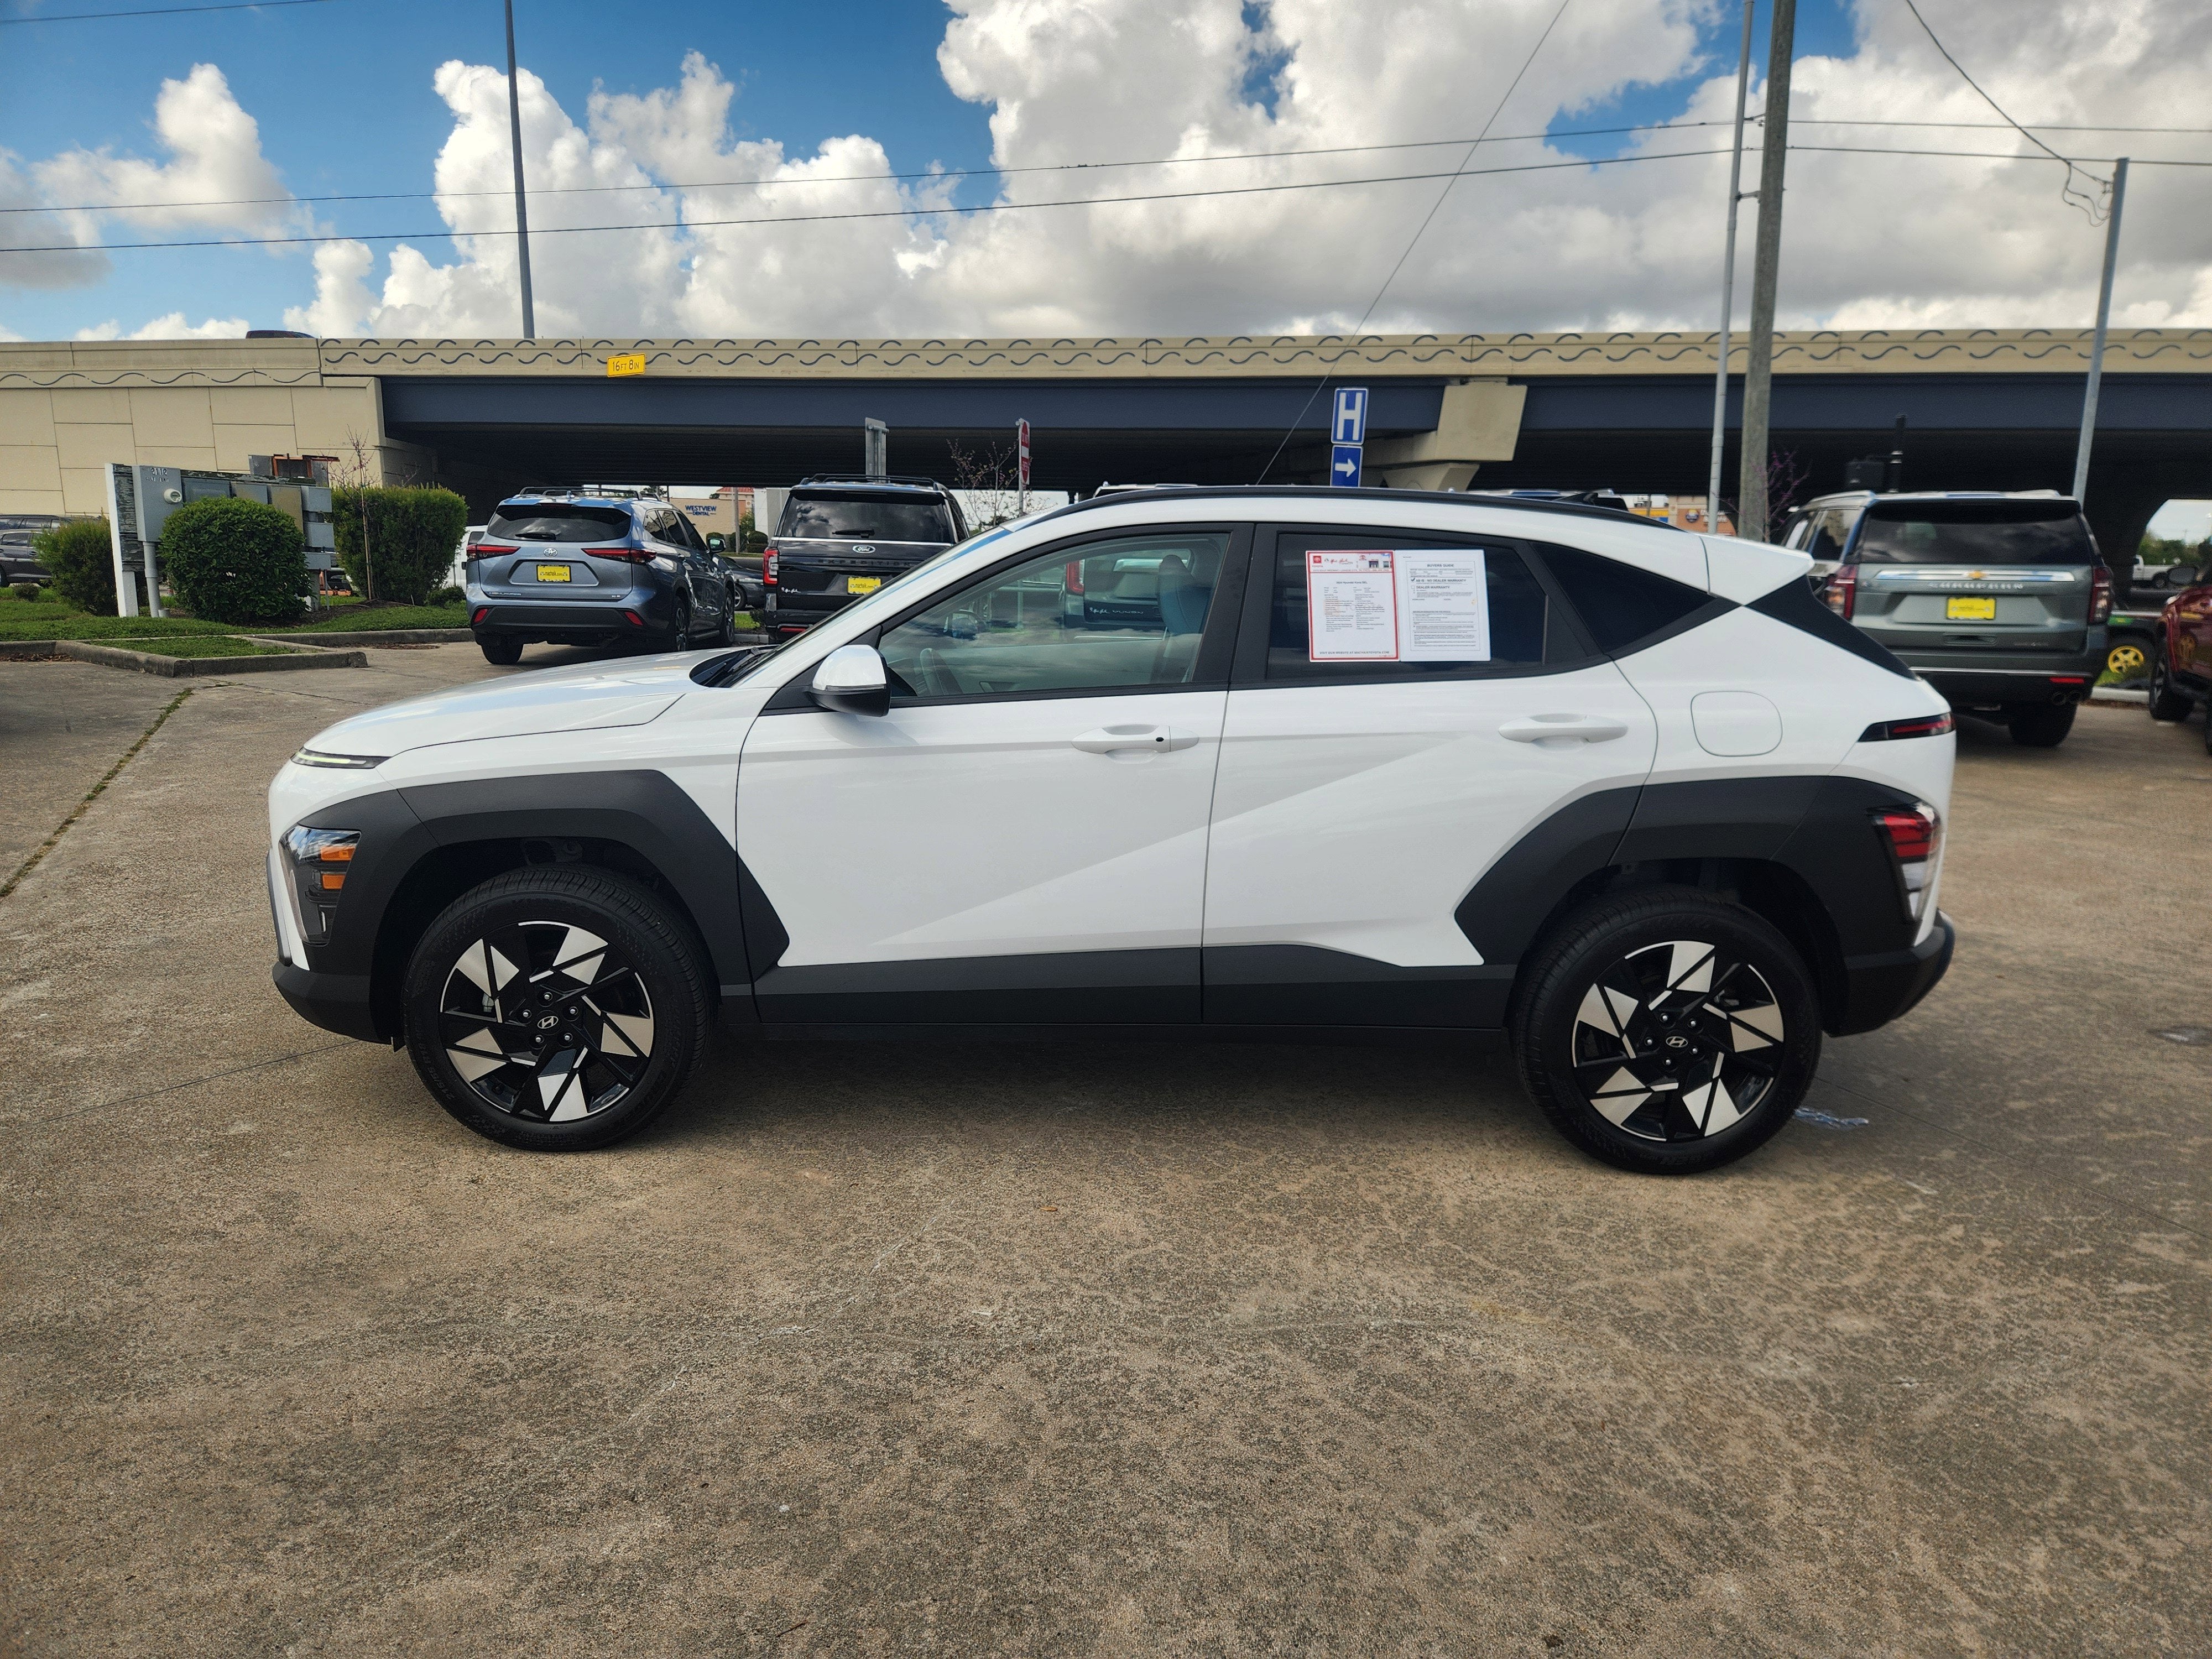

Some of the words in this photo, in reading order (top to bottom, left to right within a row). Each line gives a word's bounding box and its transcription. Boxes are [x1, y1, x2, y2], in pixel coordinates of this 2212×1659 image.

[613, 361, 627, 372] 16FT
[629, 359, 639, 370] 8IN
[1337, 392, 1363, 441] H
